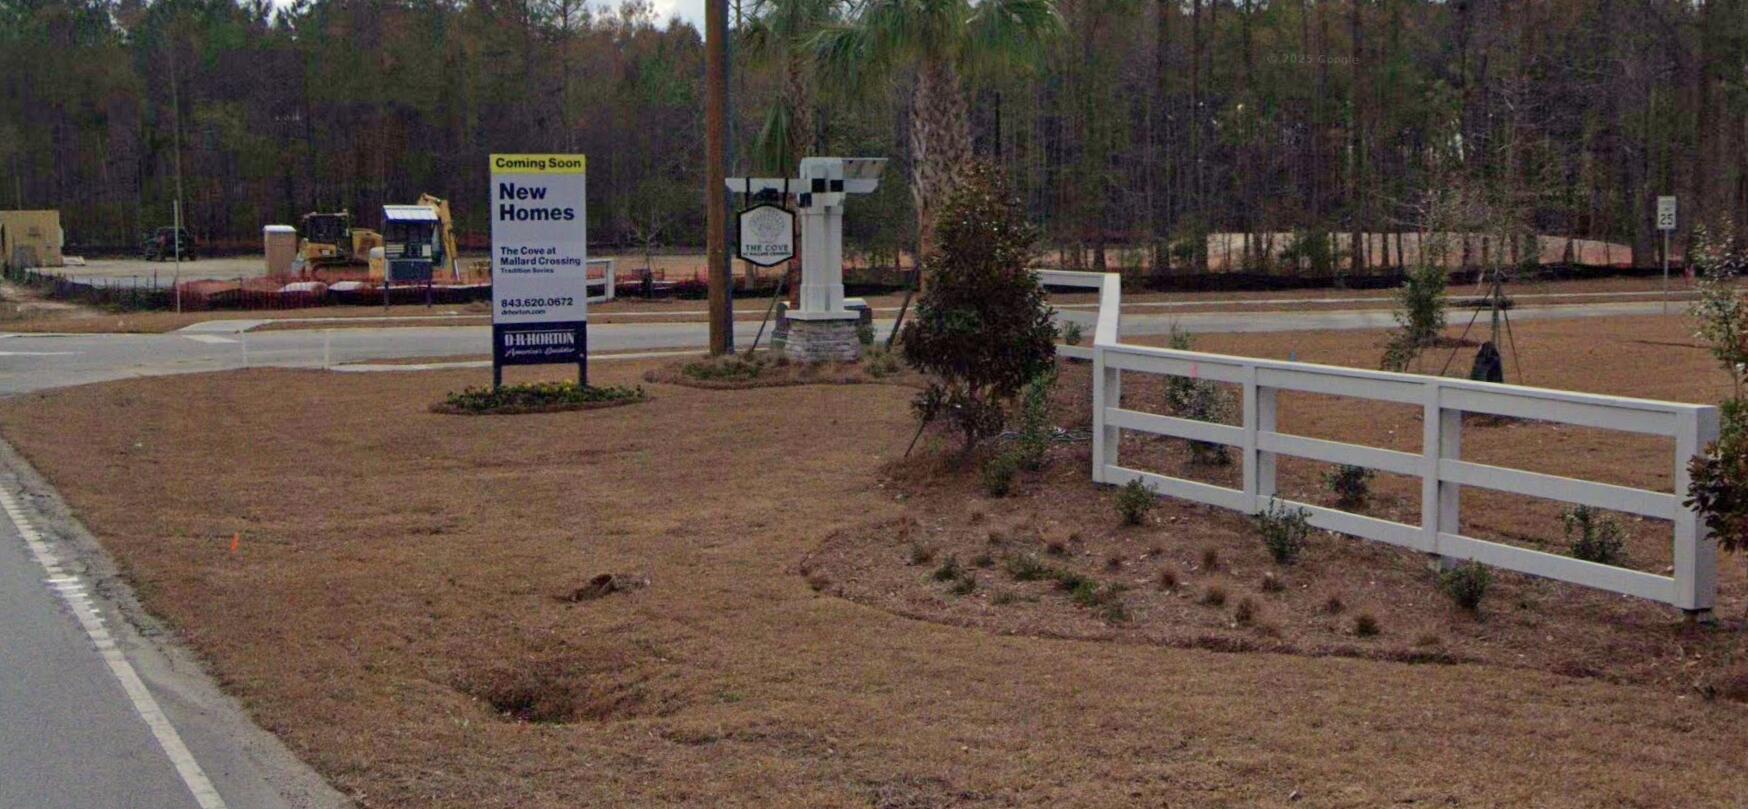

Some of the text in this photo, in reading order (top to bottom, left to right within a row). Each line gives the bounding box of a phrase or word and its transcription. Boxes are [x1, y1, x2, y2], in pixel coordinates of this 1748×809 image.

[495, 157, 582, 170] Coming Soon
[499, 182, 547, 200] New
[499, 203, 575, 221] Homes
[1659, 213, 1674, 225] 25
[500, 246, 556, 255] The Cove at
[500, 256, 582, 267] Mallard Crossing
[501, 297, 574, 308] 843.620.0672
